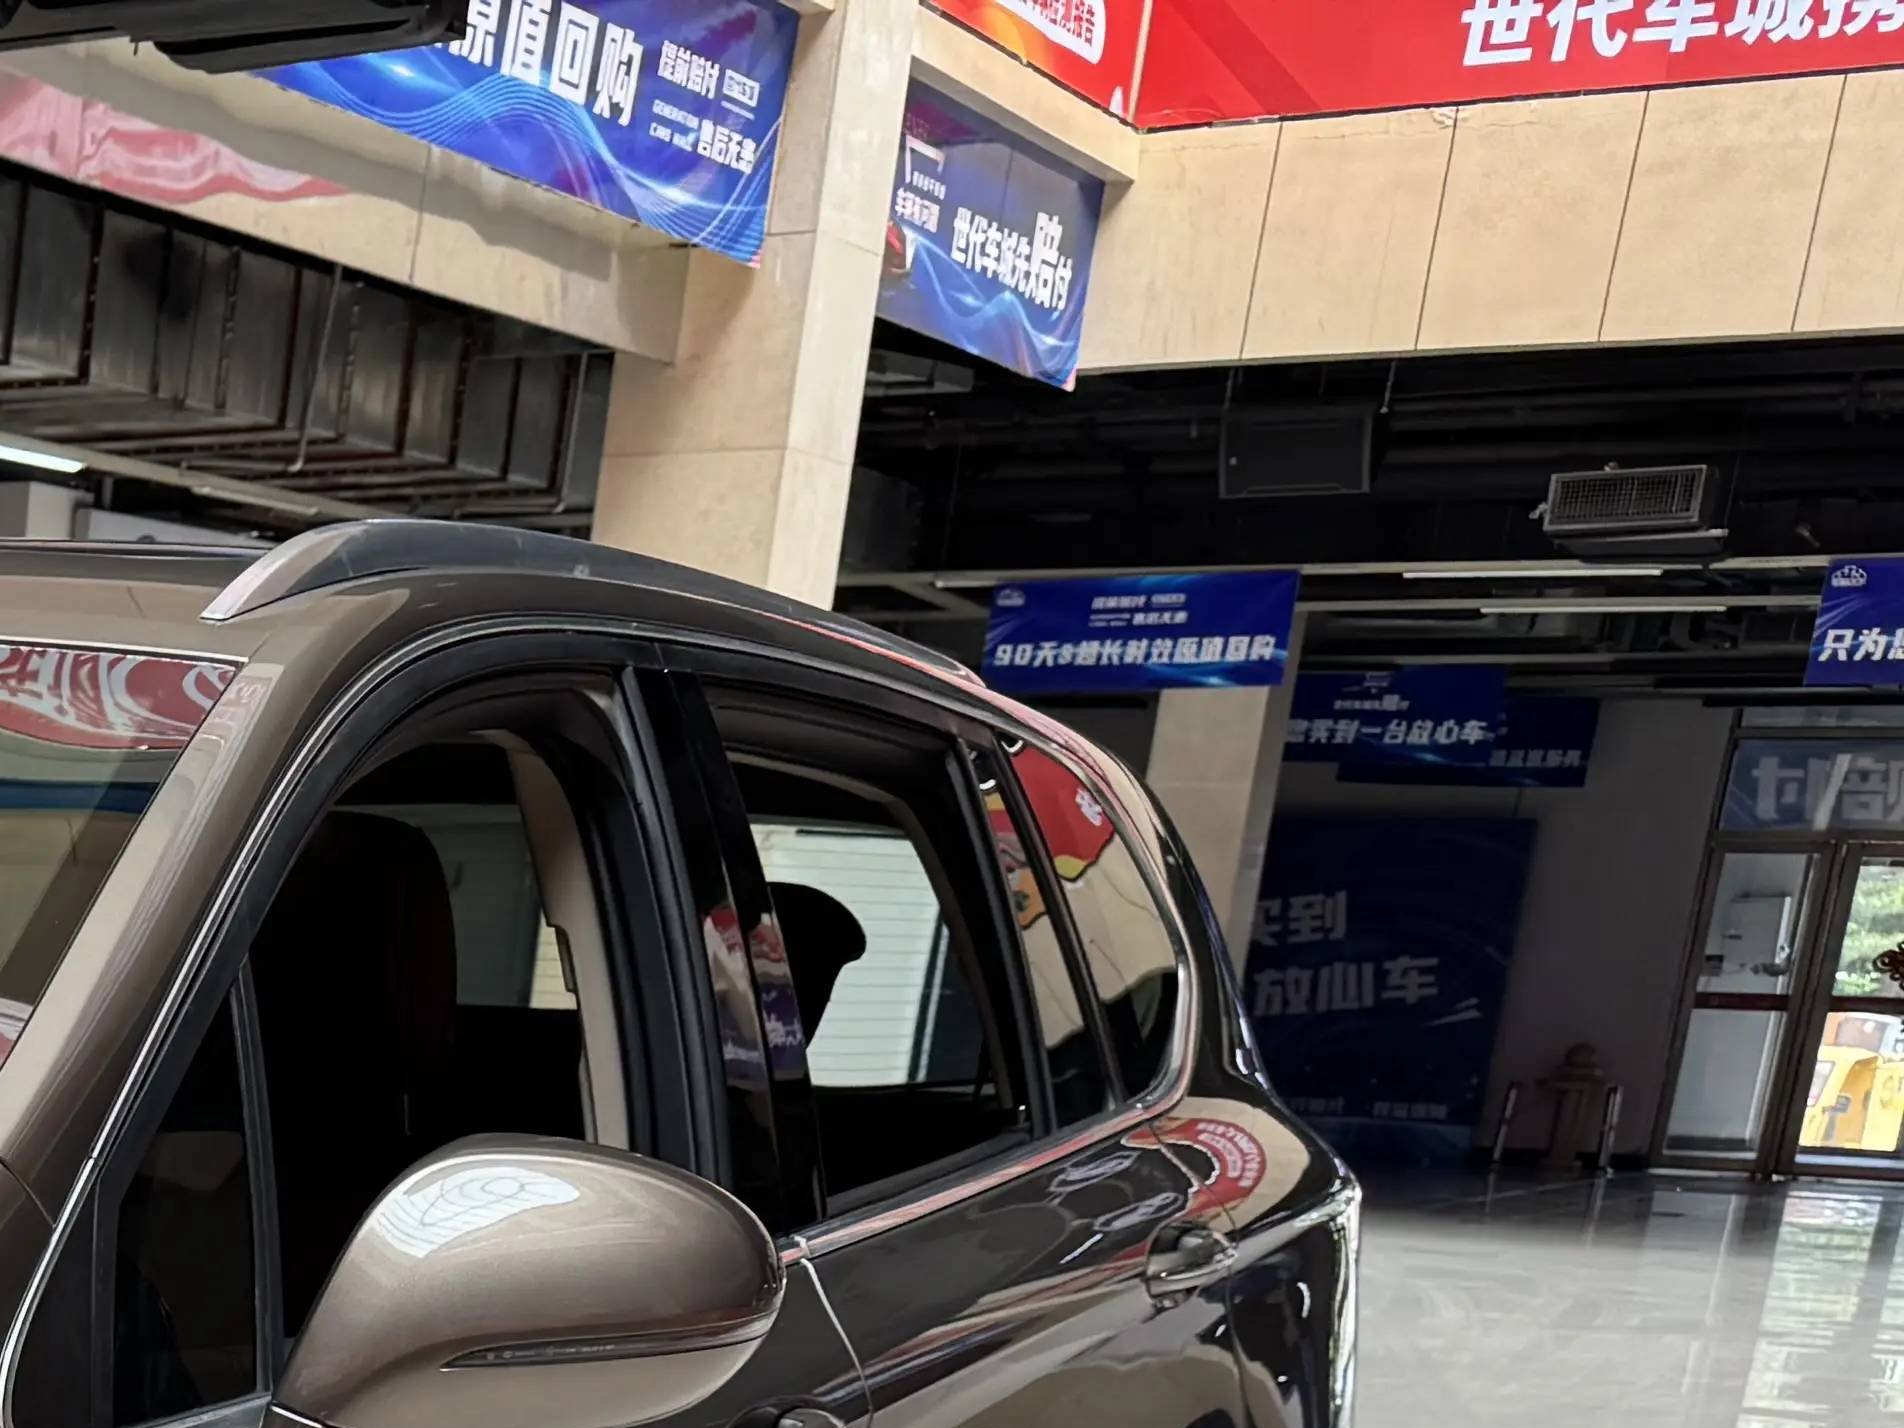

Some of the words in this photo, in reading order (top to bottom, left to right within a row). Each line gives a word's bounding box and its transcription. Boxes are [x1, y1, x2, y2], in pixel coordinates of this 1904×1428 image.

[435, 0, 644, 126] 原值回购
[1252, 955, 1440, 1018] 放心车
